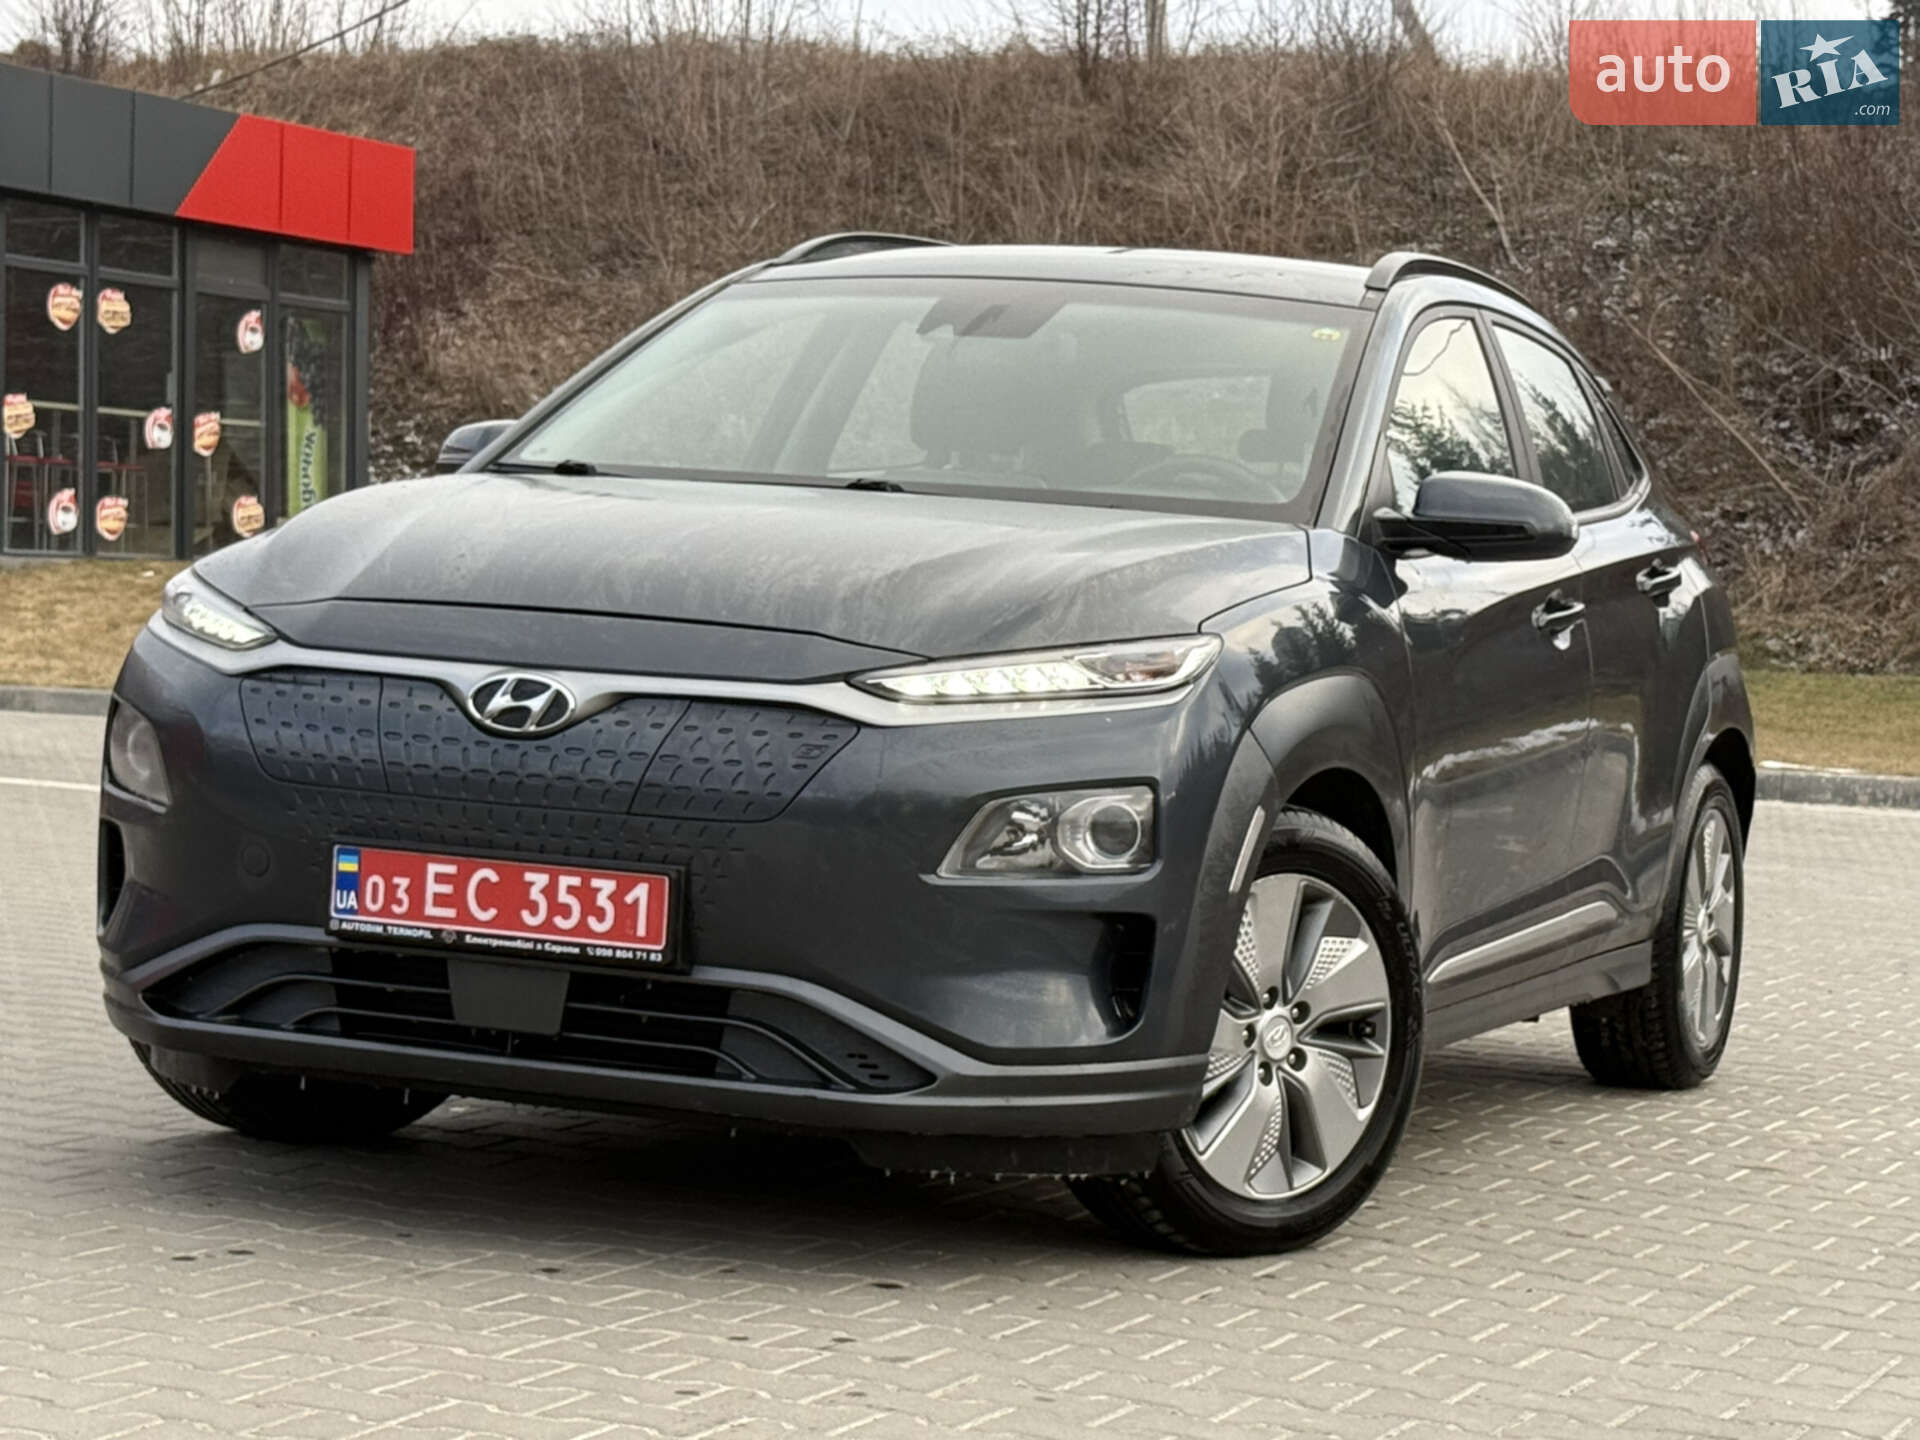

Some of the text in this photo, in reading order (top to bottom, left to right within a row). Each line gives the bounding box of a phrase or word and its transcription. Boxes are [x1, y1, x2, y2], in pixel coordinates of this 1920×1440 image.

[336, 889, 358, 910] UA
[365, 862, 649, 938] 03 EC 3531
